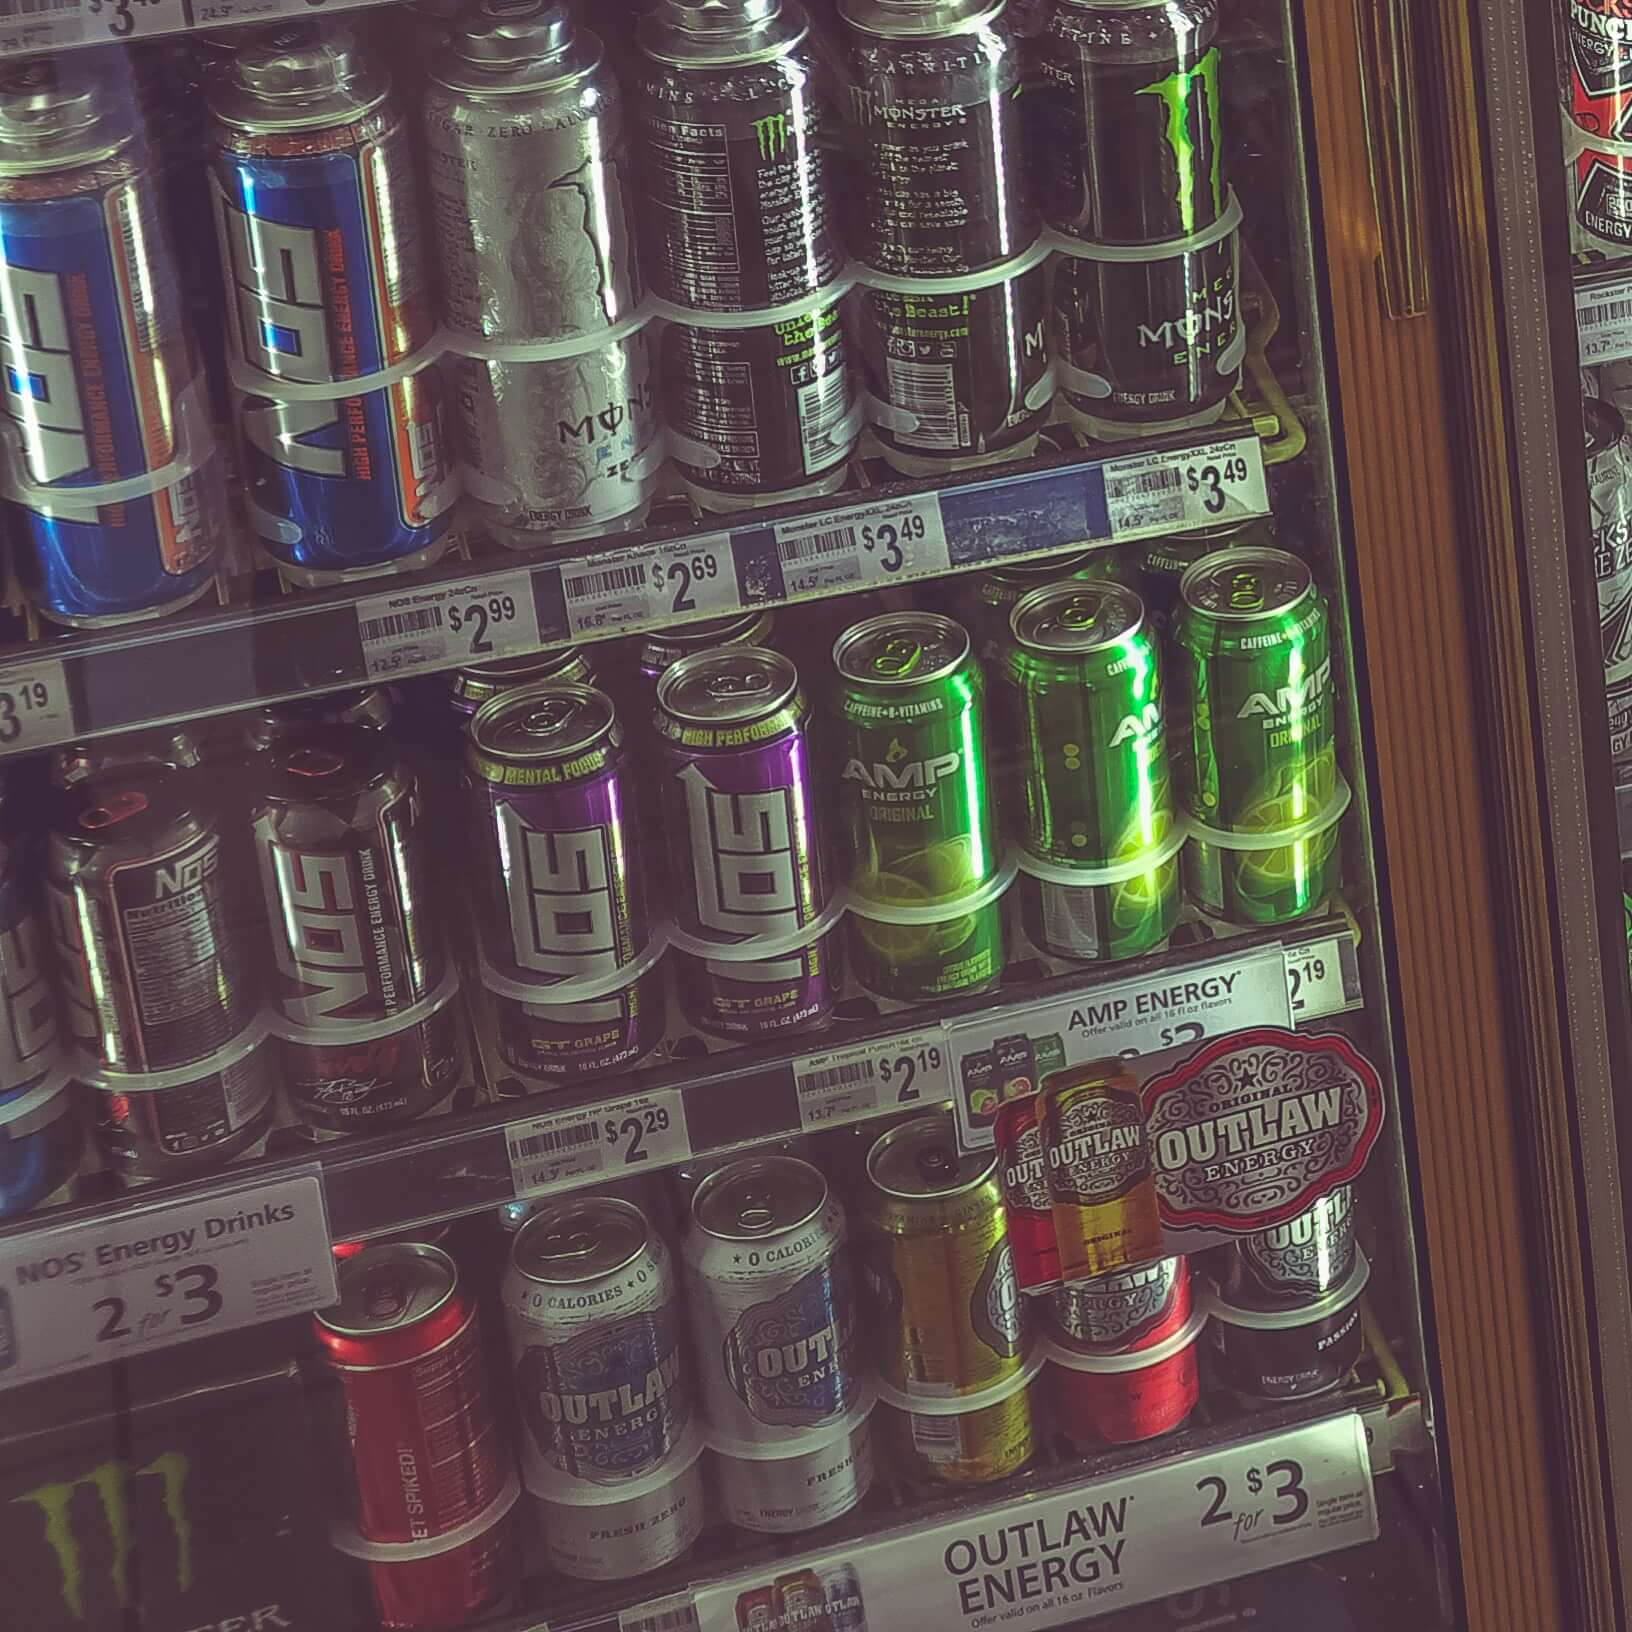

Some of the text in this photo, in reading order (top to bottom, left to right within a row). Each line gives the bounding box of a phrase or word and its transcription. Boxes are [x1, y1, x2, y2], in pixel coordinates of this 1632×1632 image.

[354, 447, 371, 480] HIGH
[842, 752, 962, 786] AMP
[861, 786, 938, 802] ENERGY
[365, 884, 383, 925] ENERGY
[373, 926, 397, 1006] PERFORMANCE
[1068, 973, 1242, 1032] AMP ENERGY
[1209, 1085, 1295, 1112] ORIGINAL
[1050, 1124, 1142, 1167] OUTLAW
[1158, 1086, 1344, 1170] OUTLAW
[1203, 1140, 1318, 1183] ENERGY
[15, 1251, 84, 1286] NOS
[96, 1226, 195, 1265] Energy
[205, 1203, 295, 1239] Drinks
[92, 1296, 132, 1343] 2
[155, 1264, 223, 1325] $3
[548, 1283, 624, 1310] CALORIES
[1195, 1476, 1233, 1527] 2
[1245, 1459, 1310, 1525] $3
[943, 1497, 1134, 1575] OUTLAW
[1232, 1510, 1265, 1543] for
[958, 1540, 1127, 1617] ENERGY
[971, 1581, 1125, 1629] Offer valid on all 16 oz Flavors
